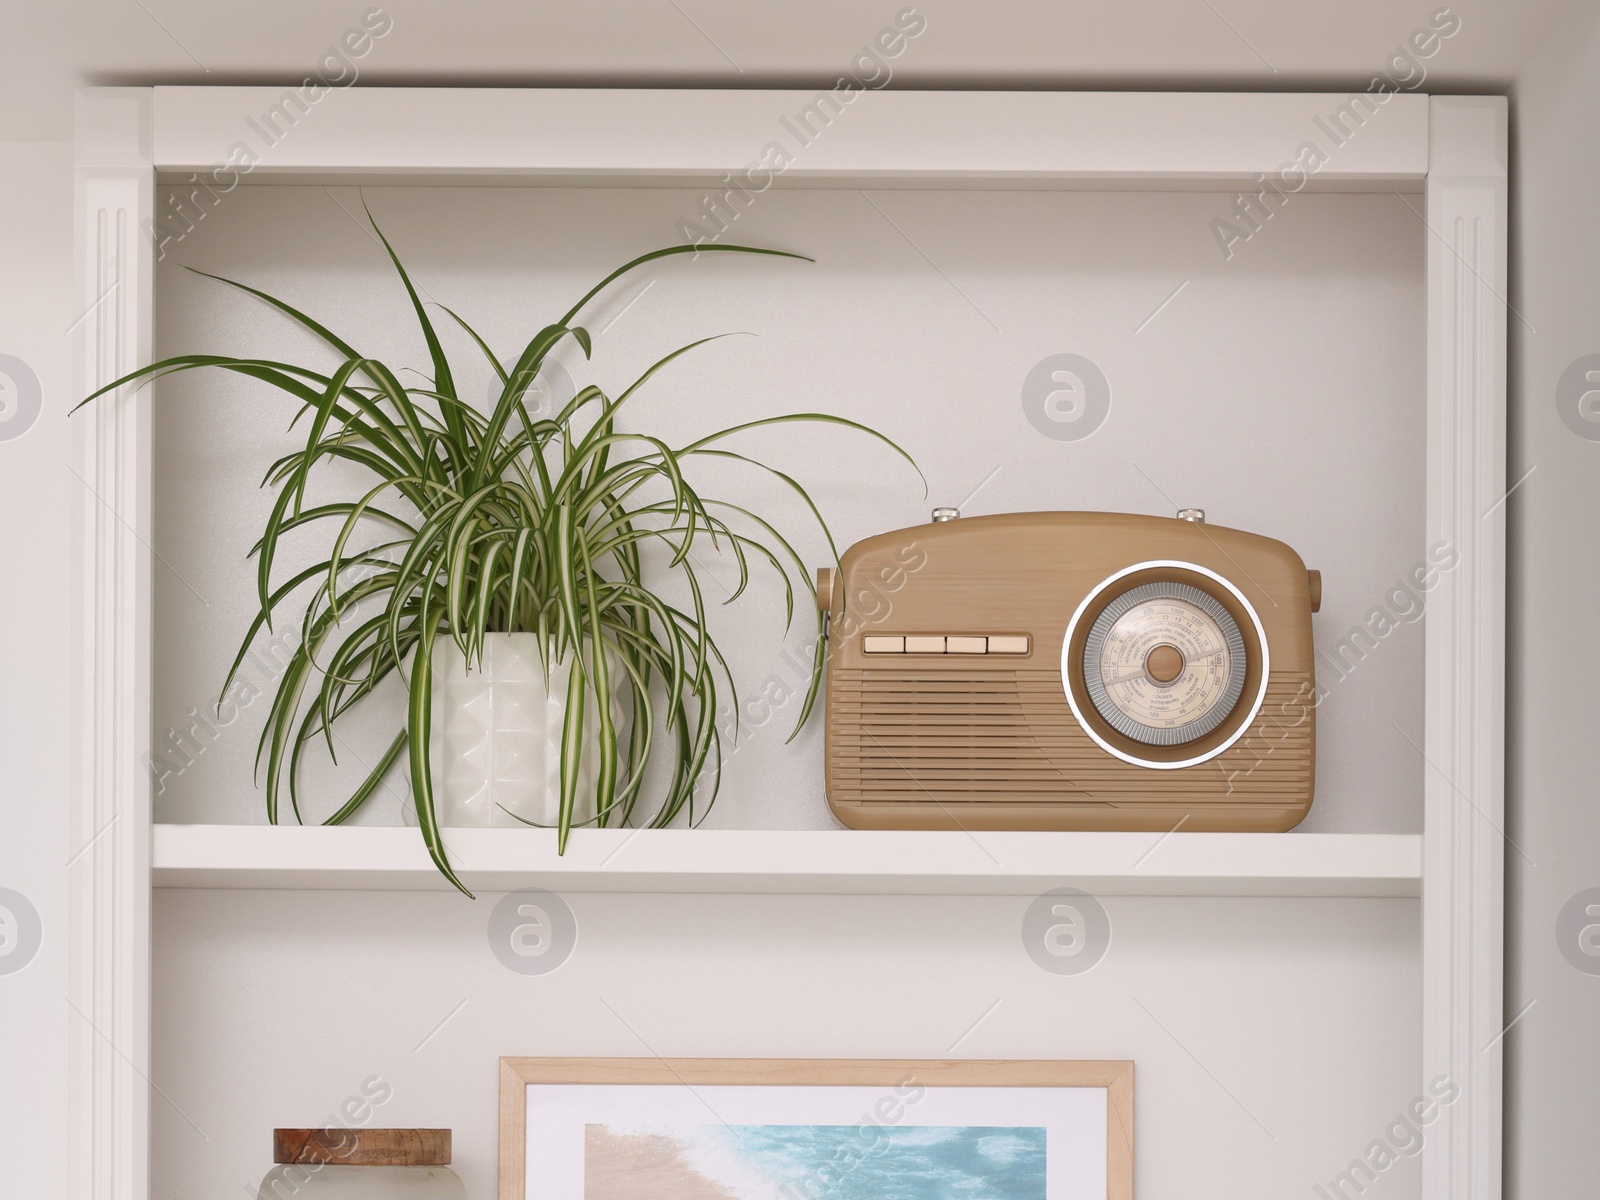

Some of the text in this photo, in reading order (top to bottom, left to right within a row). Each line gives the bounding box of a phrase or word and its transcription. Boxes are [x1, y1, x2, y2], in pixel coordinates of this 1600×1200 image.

[1171, 608, 1185, 616] 1000
[1191, 616, 1204, 627] 1200
[1185, 677, 1198, 696] GLASGOW
[1122, 694, 1131, 704] 104
